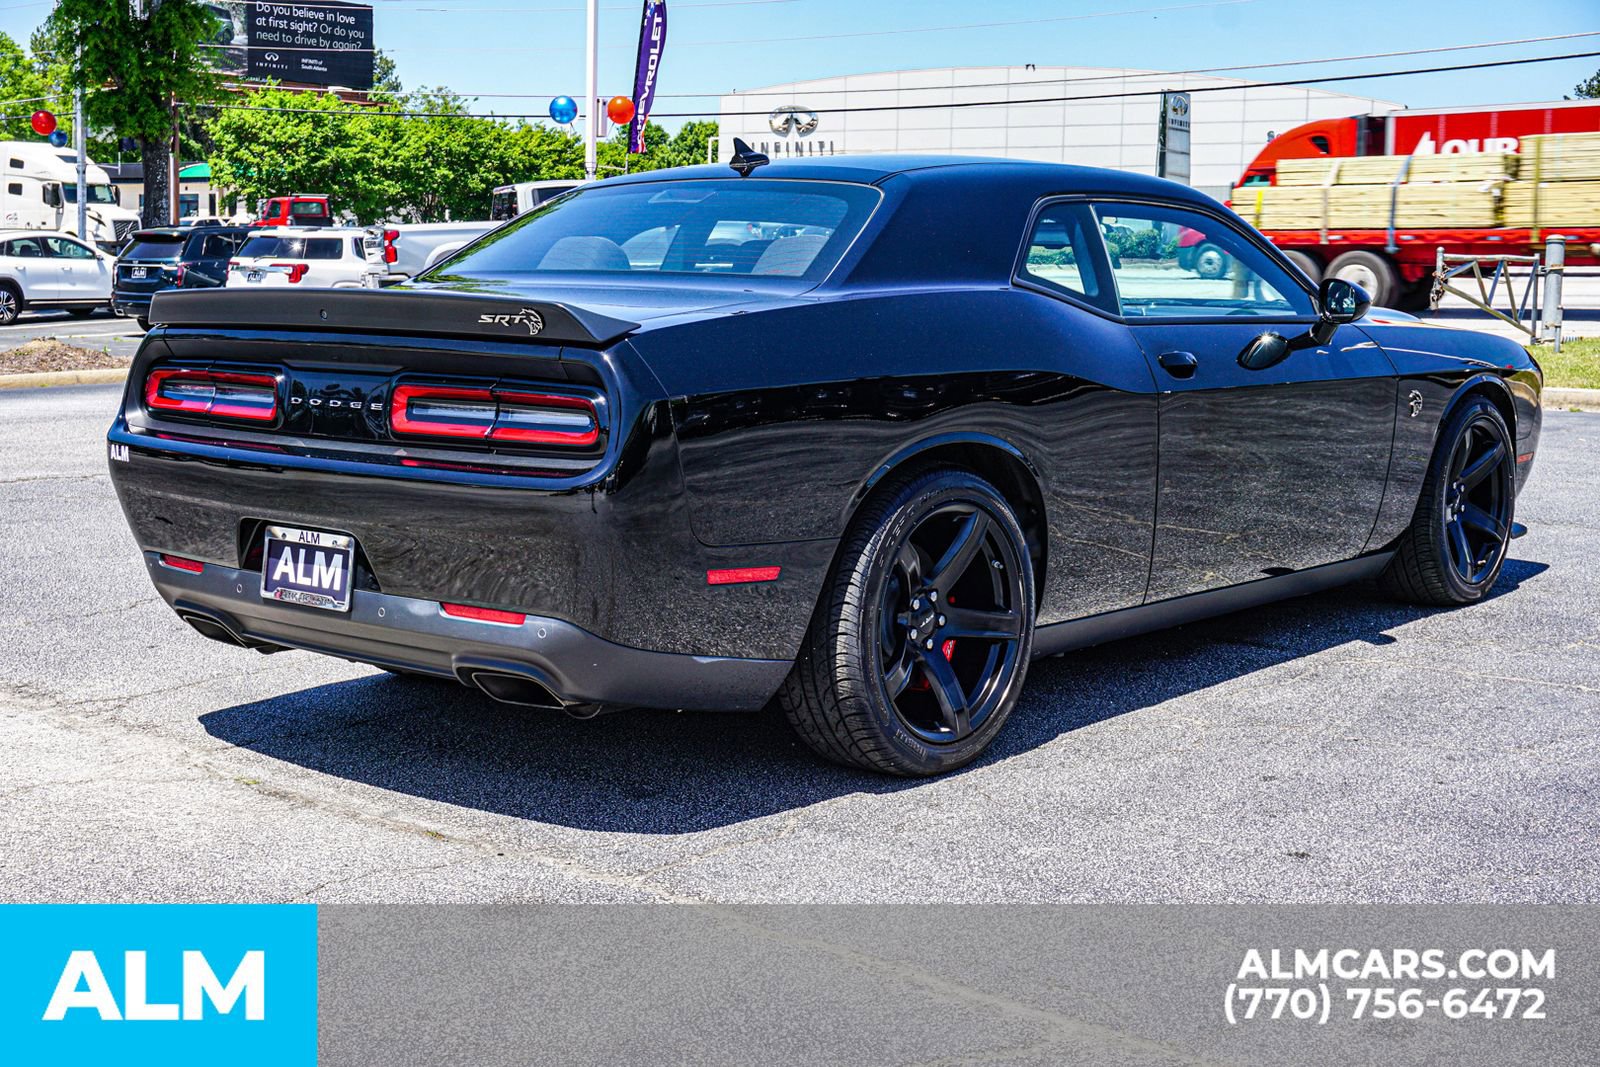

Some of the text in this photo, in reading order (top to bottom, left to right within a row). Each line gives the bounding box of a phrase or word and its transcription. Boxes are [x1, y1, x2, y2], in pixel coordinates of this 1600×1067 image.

[256, 2, 355, 24] Do you believe in love
[256, 16, 364, 39] at first sight? Or do you
[256, 31, 362, 51] need to drive by again?
[752, 140, 834, 158] INFINITI
[478, 315, 526, 326] SRT
[291, 397, 382, 410] DODGE
[111, 444, 129, 462] ALM
[299, 531, 320, 544] ALM
[273, 546, 343, 590] ALM
